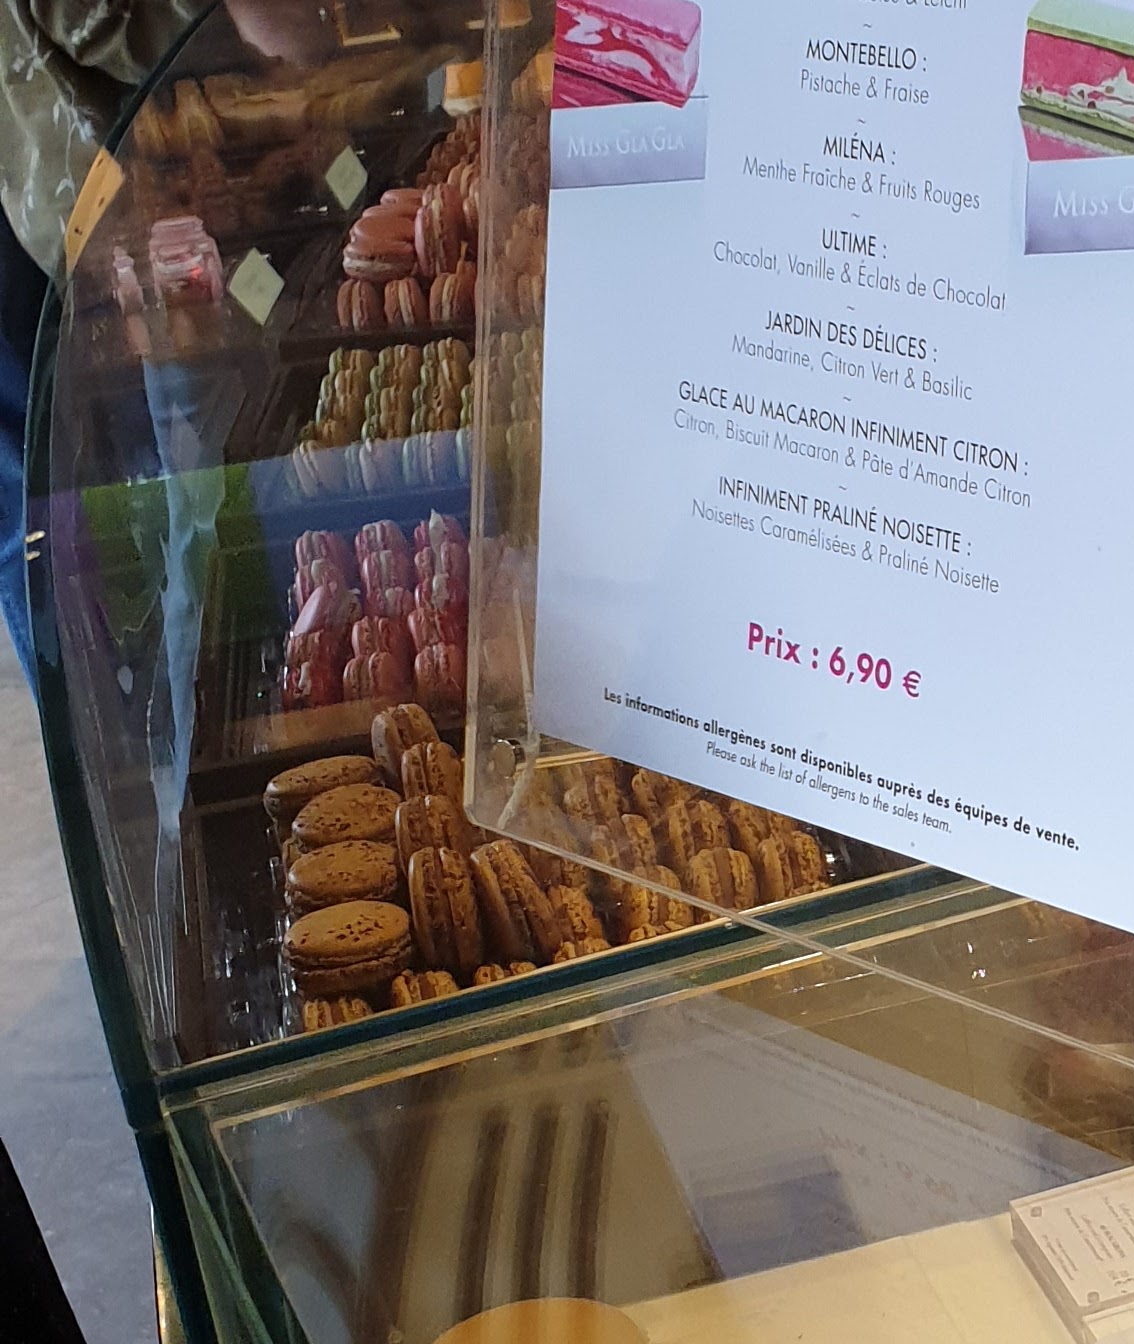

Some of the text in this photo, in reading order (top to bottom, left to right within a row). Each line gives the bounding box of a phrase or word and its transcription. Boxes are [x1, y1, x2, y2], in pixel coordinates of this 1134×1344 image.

[800, 69, 929, 105] Pistache & Fraise
[806, 39, 917, 71] MONTEBELLO
[823, 132, 885, 163] MILÉNA
[743, 156, 980, 213] Menthe Fraîche & Fruits Rouges
[713, 240, 1006, 311] Chocolat, Vanille & Éclats de Chocolat
[821, 228, 877, 257] ULTIME
[732, 335, 972, 401] Mandarine, Citron Vert & Basilic
[765, 310, 822, 340] JARDIN
[827, 321, 857, 347] DES
[863, 324, 927, 360] DÉLICES
[674, 409, 719, 440] Citron,
[726, 419, 770, 449] Biscuit
[773, 431, 839, 463] Macaron
[845, 446, 856, 468] &
[862, 449, 894, 476] Pâte
[984, 478, 1031, 508] Citron
[679, 381, 728, 409] GLACE
[732, 394, 755, 416] AU
[760, 399, 846, 435] MACARON
[851, 416, 948, 457] INFINIMENT
[953, 440, 1018, 473] CITRON
[692, 498, 999, 593] Noisettes Caramélisées & Praliné Noisette
[719, 476, 808, 515] INFINIMENT
[813, 497, 877, 532] PRALINÉ
[882, 515, 961, 553] NOISETTE
[748, 622, 800, 664] Prix
[829, 646, 892, 690] 6,90
[903, 670, 922, 698] €
[604, 687, 1079, 851] Les informations allergènes sont disponibles auprès des équipes de vente.
[706, 740, 952, 834] Please ask the list of allergens to the sales team.
